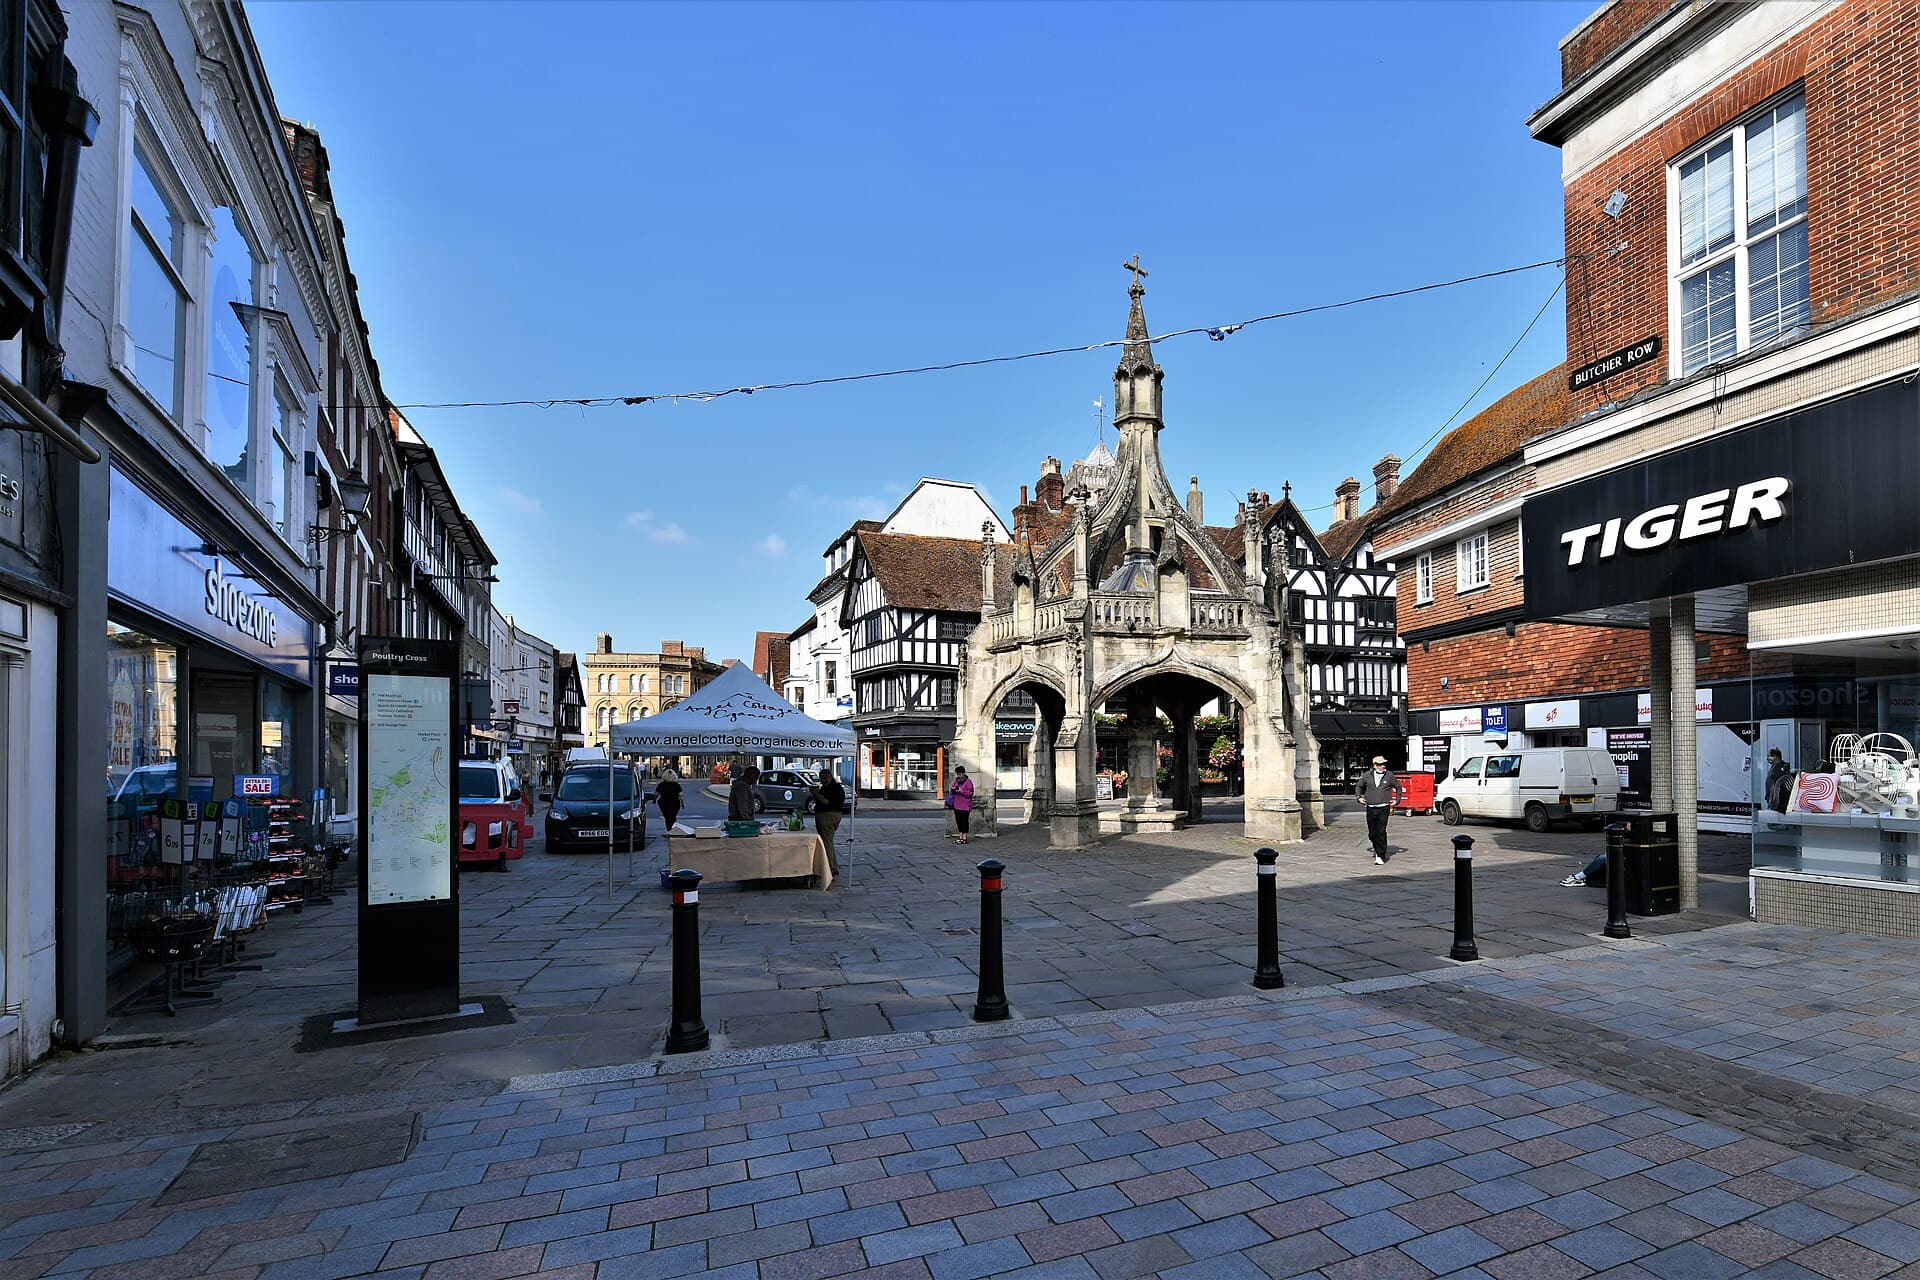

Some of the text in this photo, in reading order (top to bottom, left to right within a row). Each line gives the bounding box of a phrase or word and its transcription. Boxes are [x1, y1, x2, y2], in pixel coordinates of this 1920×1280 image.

[1575, 341, 1654, 385] BUTCHER ROW
[1560, 476, 1789, 566] TIGER
[206, 559, 277, 648] shoezone
[372, 653, 427, 662] Poultry Cross
[743, 700, 799, 717] Cottage
[995, 721, 1035, 732] akeaway
[1493, 716, 1504, 726] LET
[624, 734, 843, 750] www.angelcottageorganics.co.uk
[1610, 750, 1639, 763] maplin
[245, 783, 271, 793] SALE
[165, 835, 179, 849] 6.99
